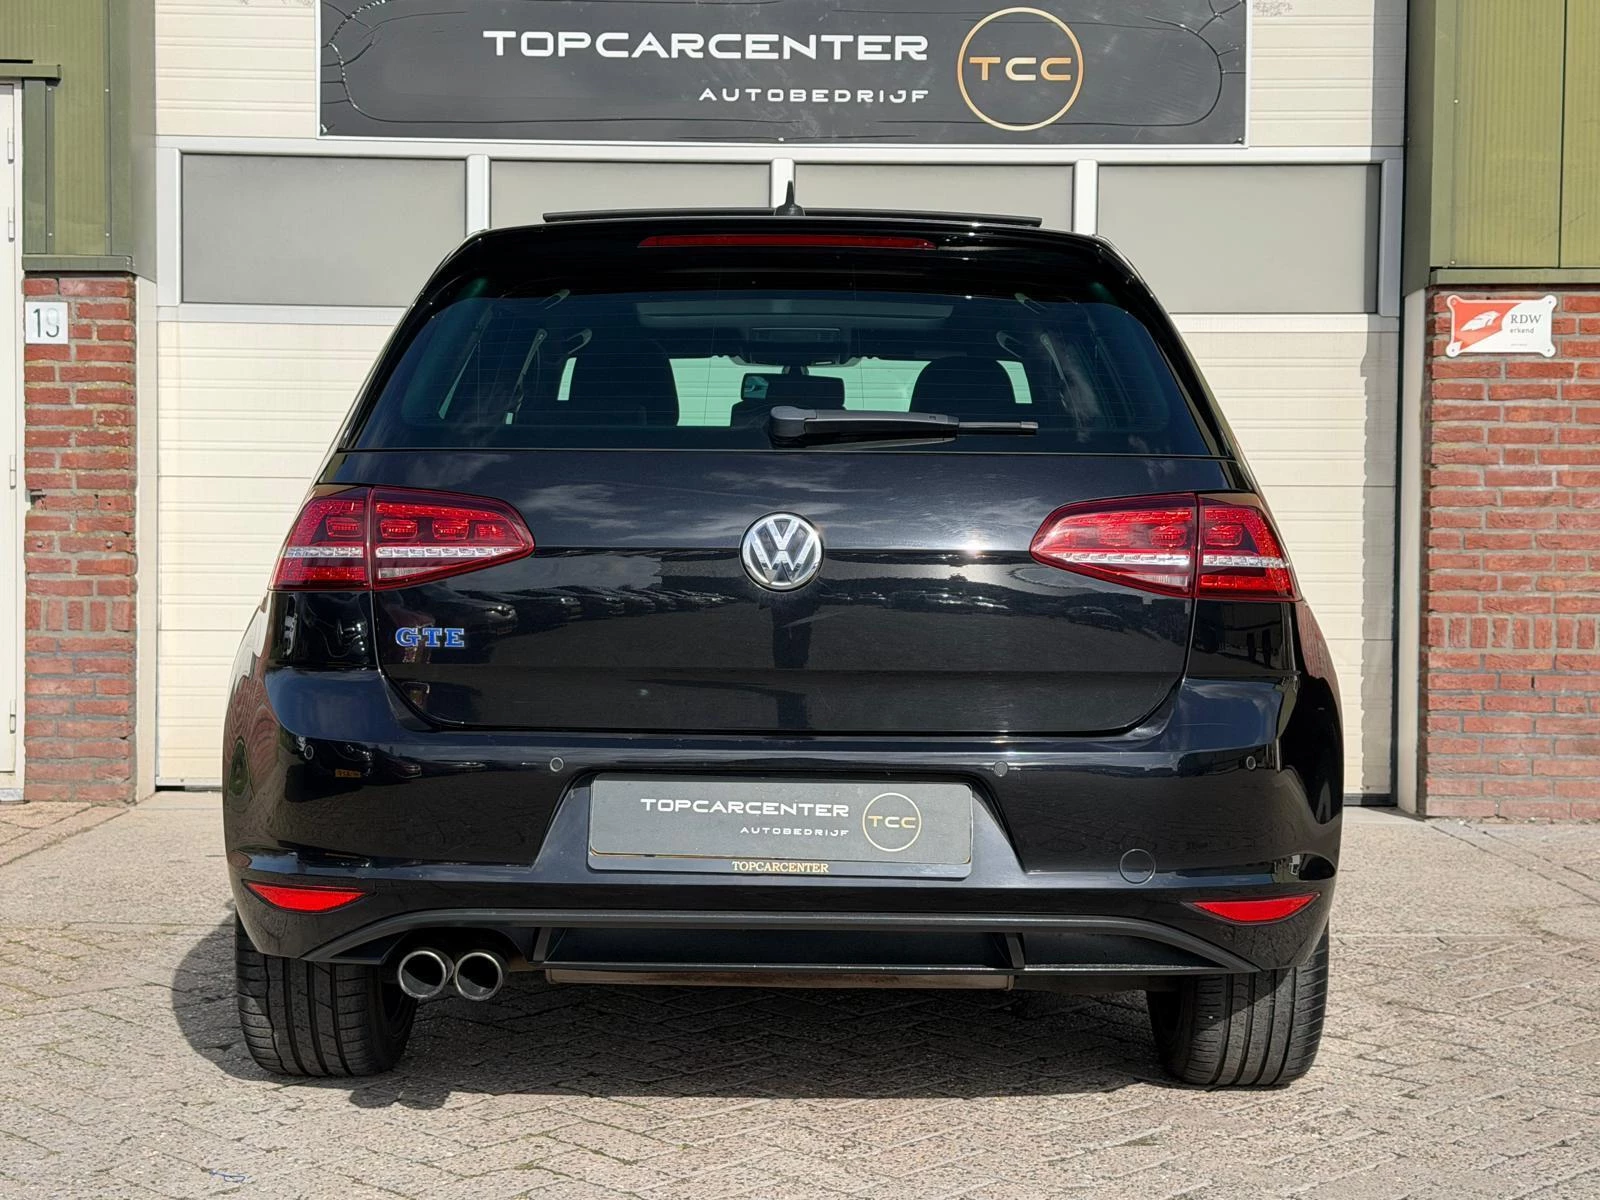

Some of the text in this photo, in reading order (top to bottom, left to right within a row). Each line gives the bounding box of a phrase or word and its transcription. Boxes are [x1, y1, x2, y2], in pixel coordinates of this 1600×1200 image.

[483, 30, 929, 61] TOPCARCENTER
[969, 56, 1072, 81] TCC
[699, 88, 929, 104] AUTOBEDRIJF
[33, 307, 60, 338] 19
[1510, 314, 1542, 324] RDW
[1510, 326, 1535, 334] erkend
[395, 627, 465, 648] GTE
[640, 797, 849, 818] TOPCARCENTER
[868, 815, 916, 829] TCC
[739, 826, 849, 837] AUTOBEDRIJF
[731, 860, 829, 874] TOPCARCENTER
